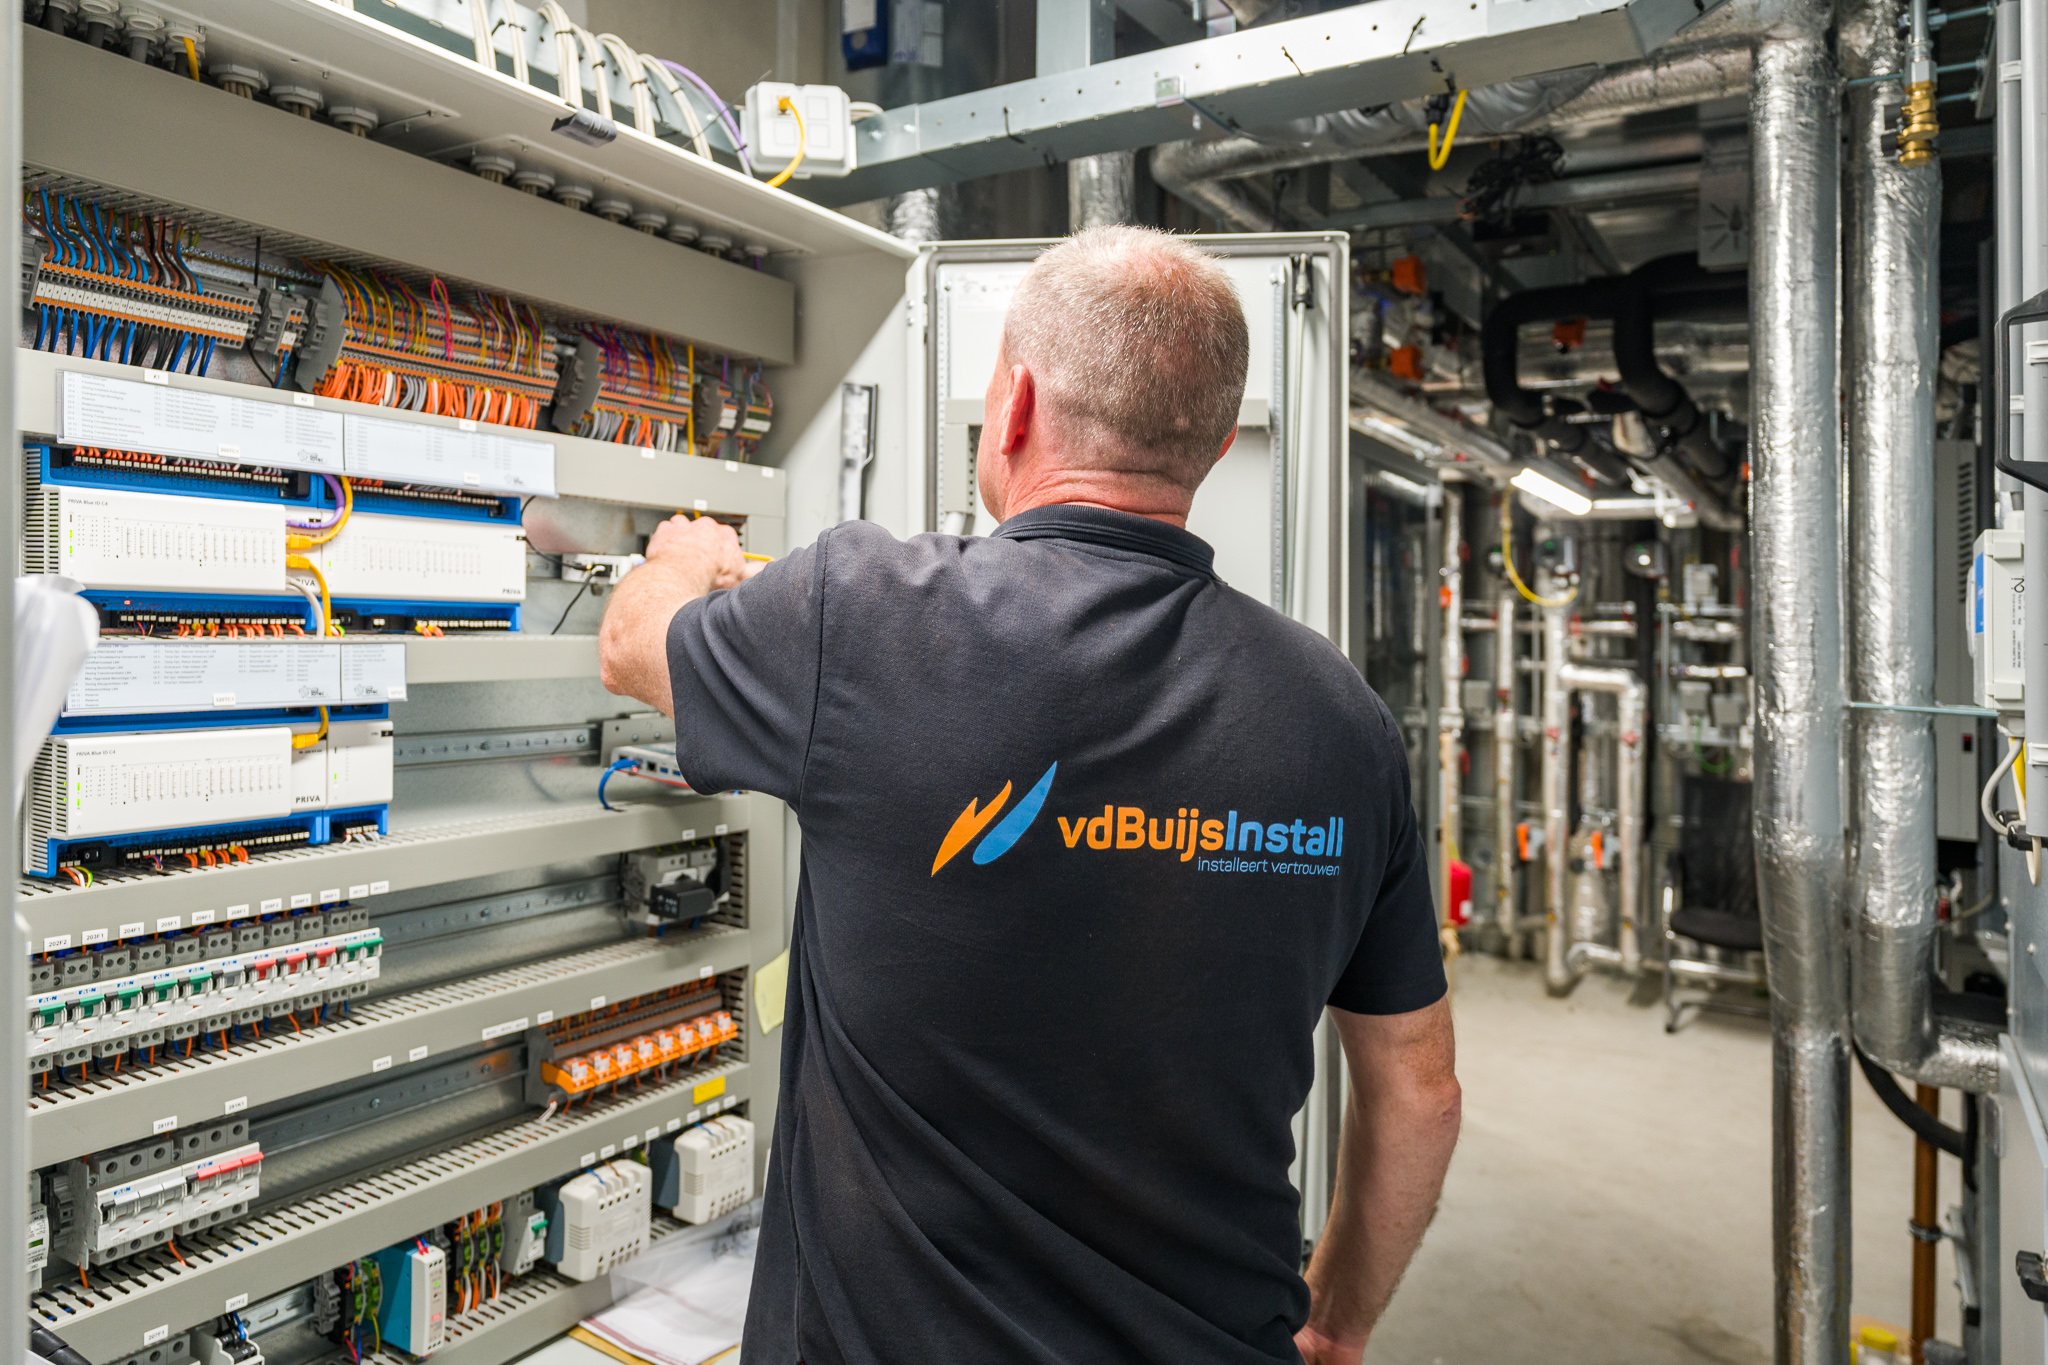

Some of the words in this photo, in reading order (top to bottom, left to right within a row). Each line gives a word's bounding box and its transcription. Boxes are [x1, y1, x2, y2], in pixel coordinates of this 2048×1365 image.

[295, 794, 321, 804] PRIVA
[1057, 804, 1344, 863] vdBuijsInstall
[1197, 857, 1268, 874] installeert
[1270, 861, 1340, 877] vertrouwen
[86, 932, 104, 941] 203F1
[48, 938, 68, 948] 202F2
